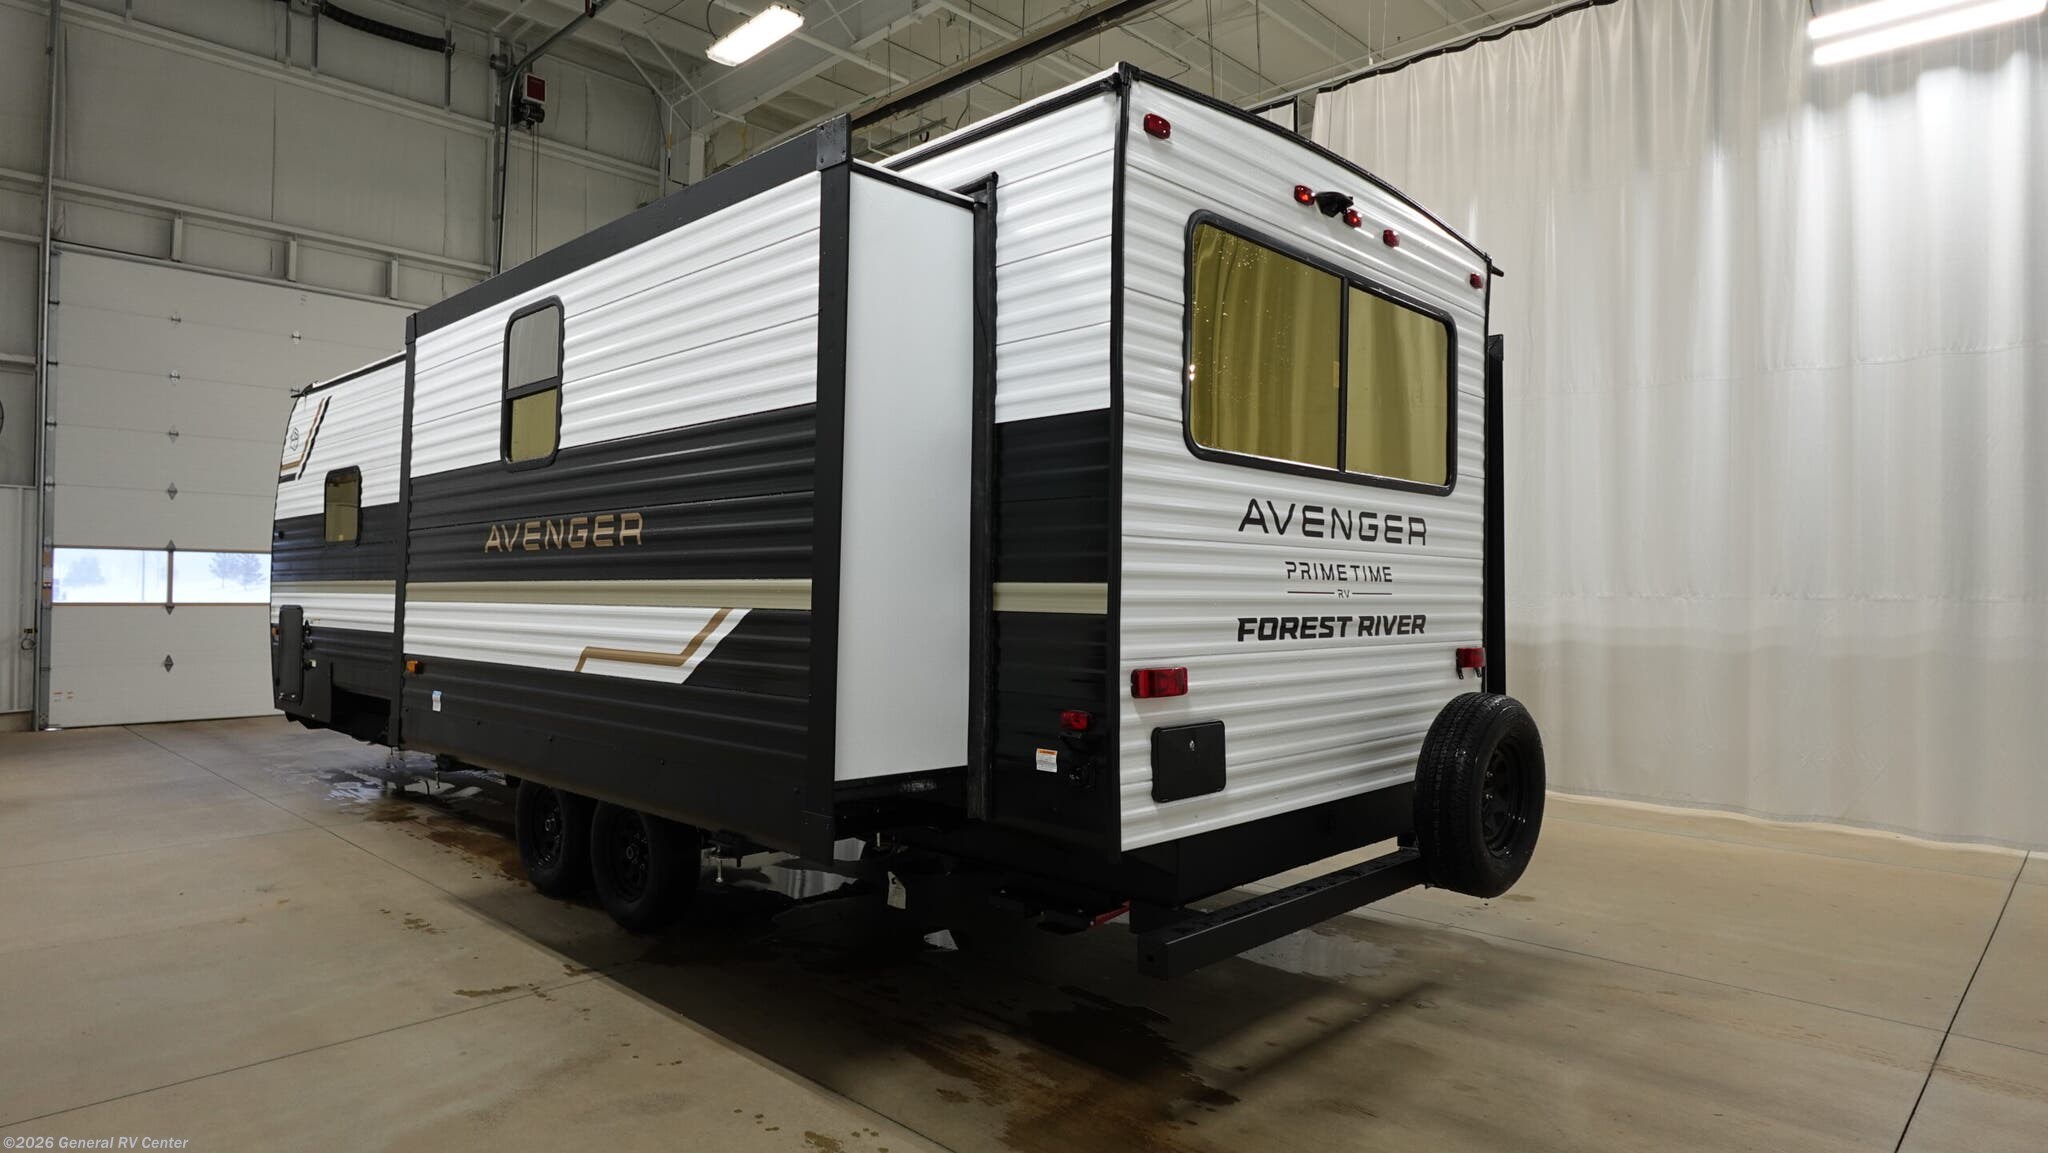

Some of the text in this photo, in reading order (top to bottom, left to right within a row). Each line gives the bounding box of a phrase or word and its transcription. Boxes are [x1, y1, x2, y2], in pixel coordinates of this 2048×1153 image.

[485, 512, 643, 553] AVENGER
[1238, 498, 1427, 546] AVENGER
[1337, 588, 1351, 599] RV
[1237, 614, 1427, 642] FOREST RIVER
